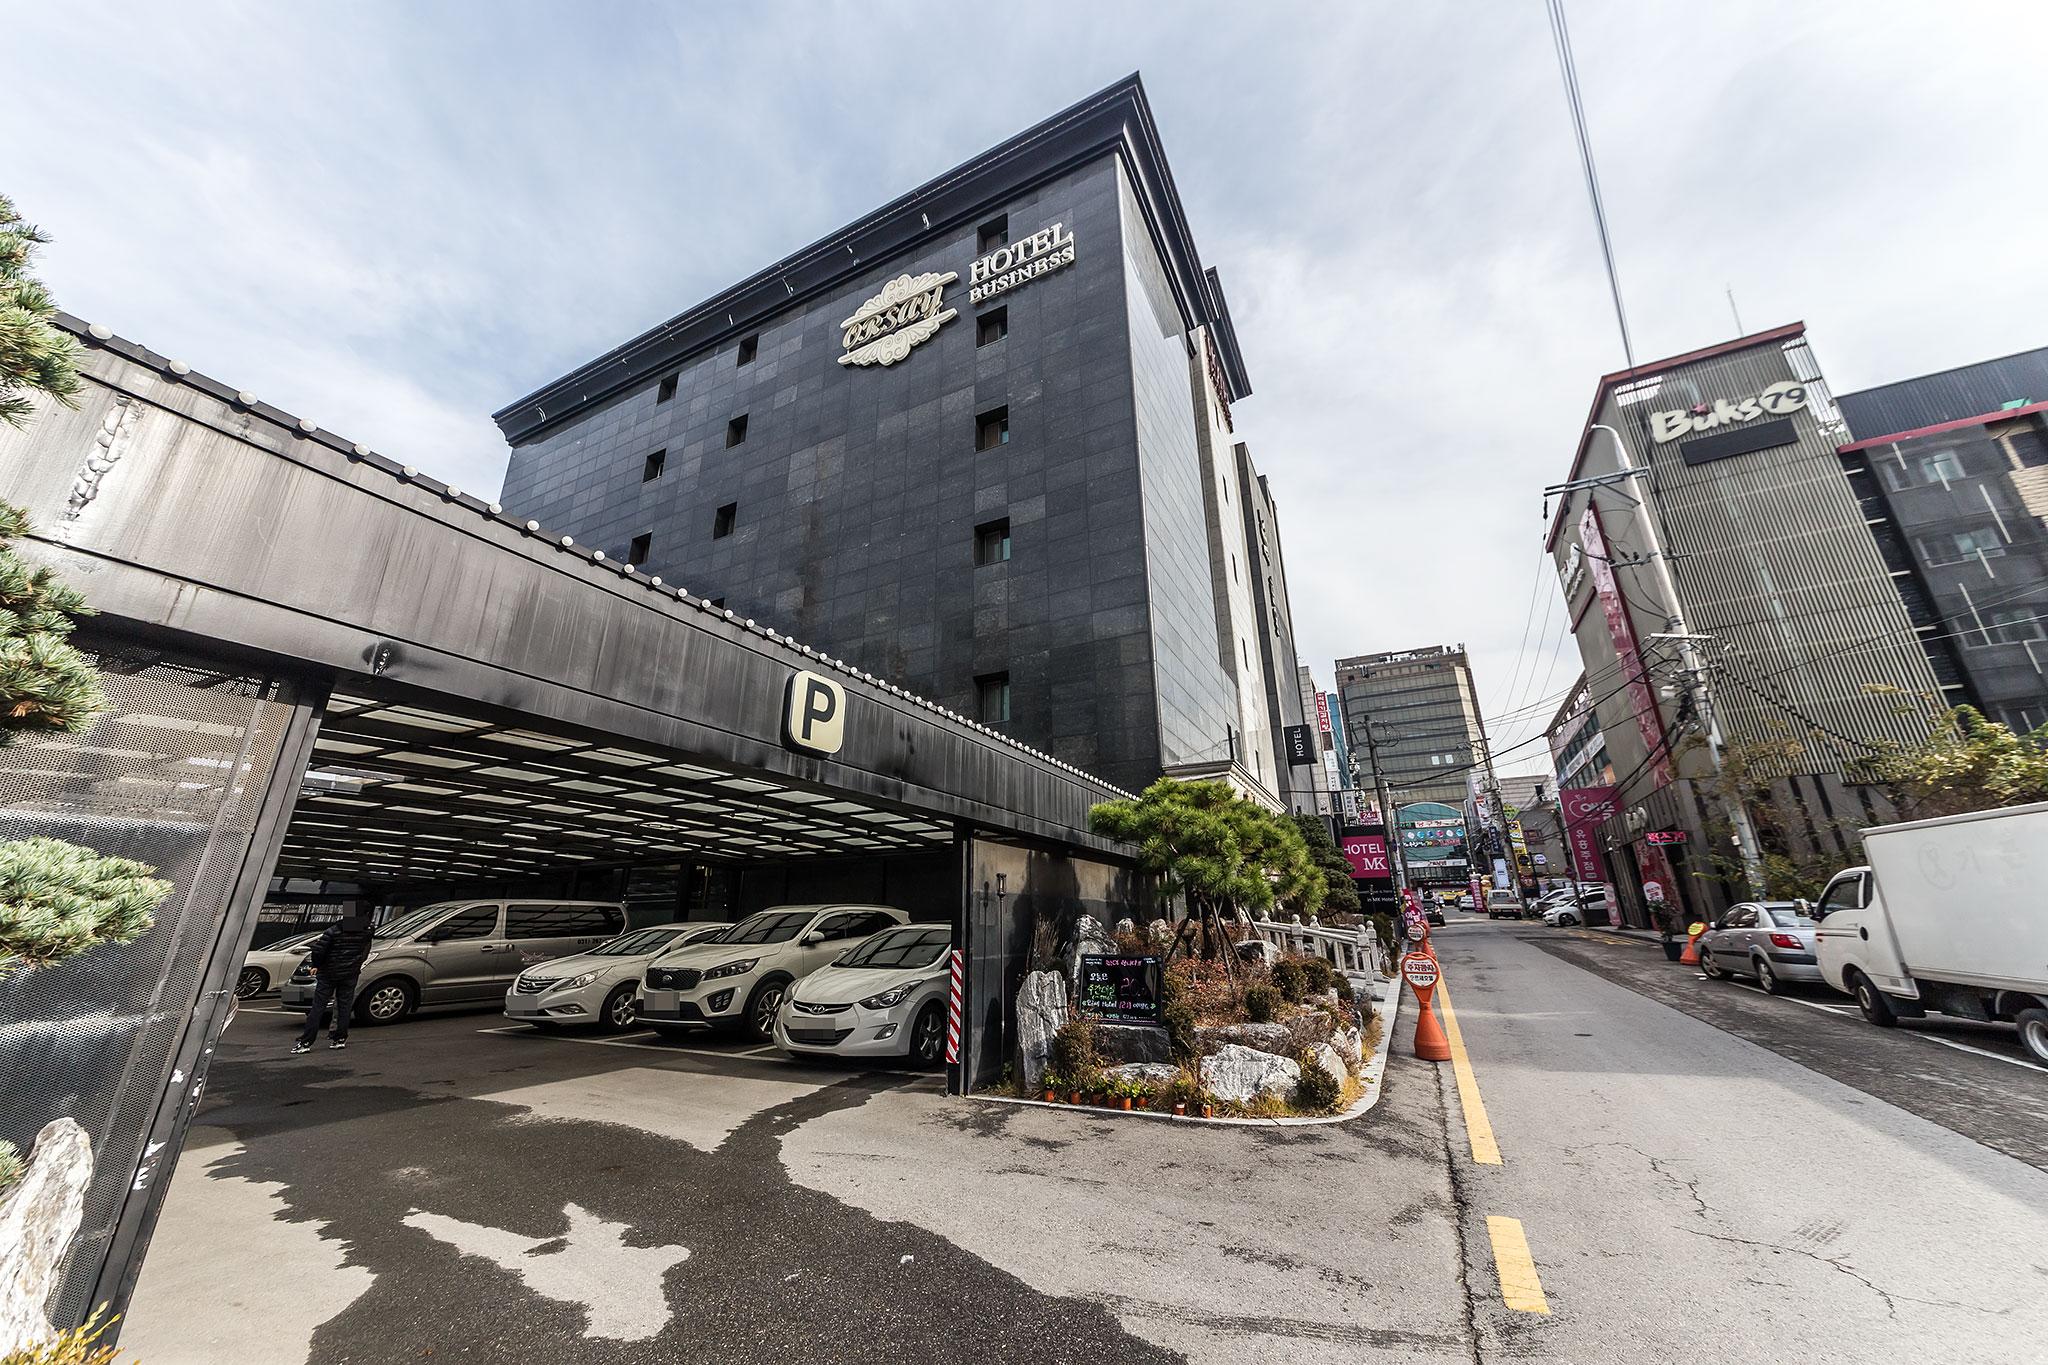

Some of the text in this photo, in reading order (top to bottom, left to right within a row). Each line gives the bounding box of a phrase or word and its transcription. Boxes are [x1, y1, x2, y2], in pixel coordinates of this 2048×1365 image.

[969, 223, 1074, 285] HOTEL
[969, 247, 1075, 304] BUSINESS
[801, 677, 836, 740] P
[1295, 727, 1304, 757] HOTEL
[1344, 843, 1385, 855] HOTEL
[1362, 857, 1388, 871] MK
[1407, 963, 1435, 972] 주차금지
